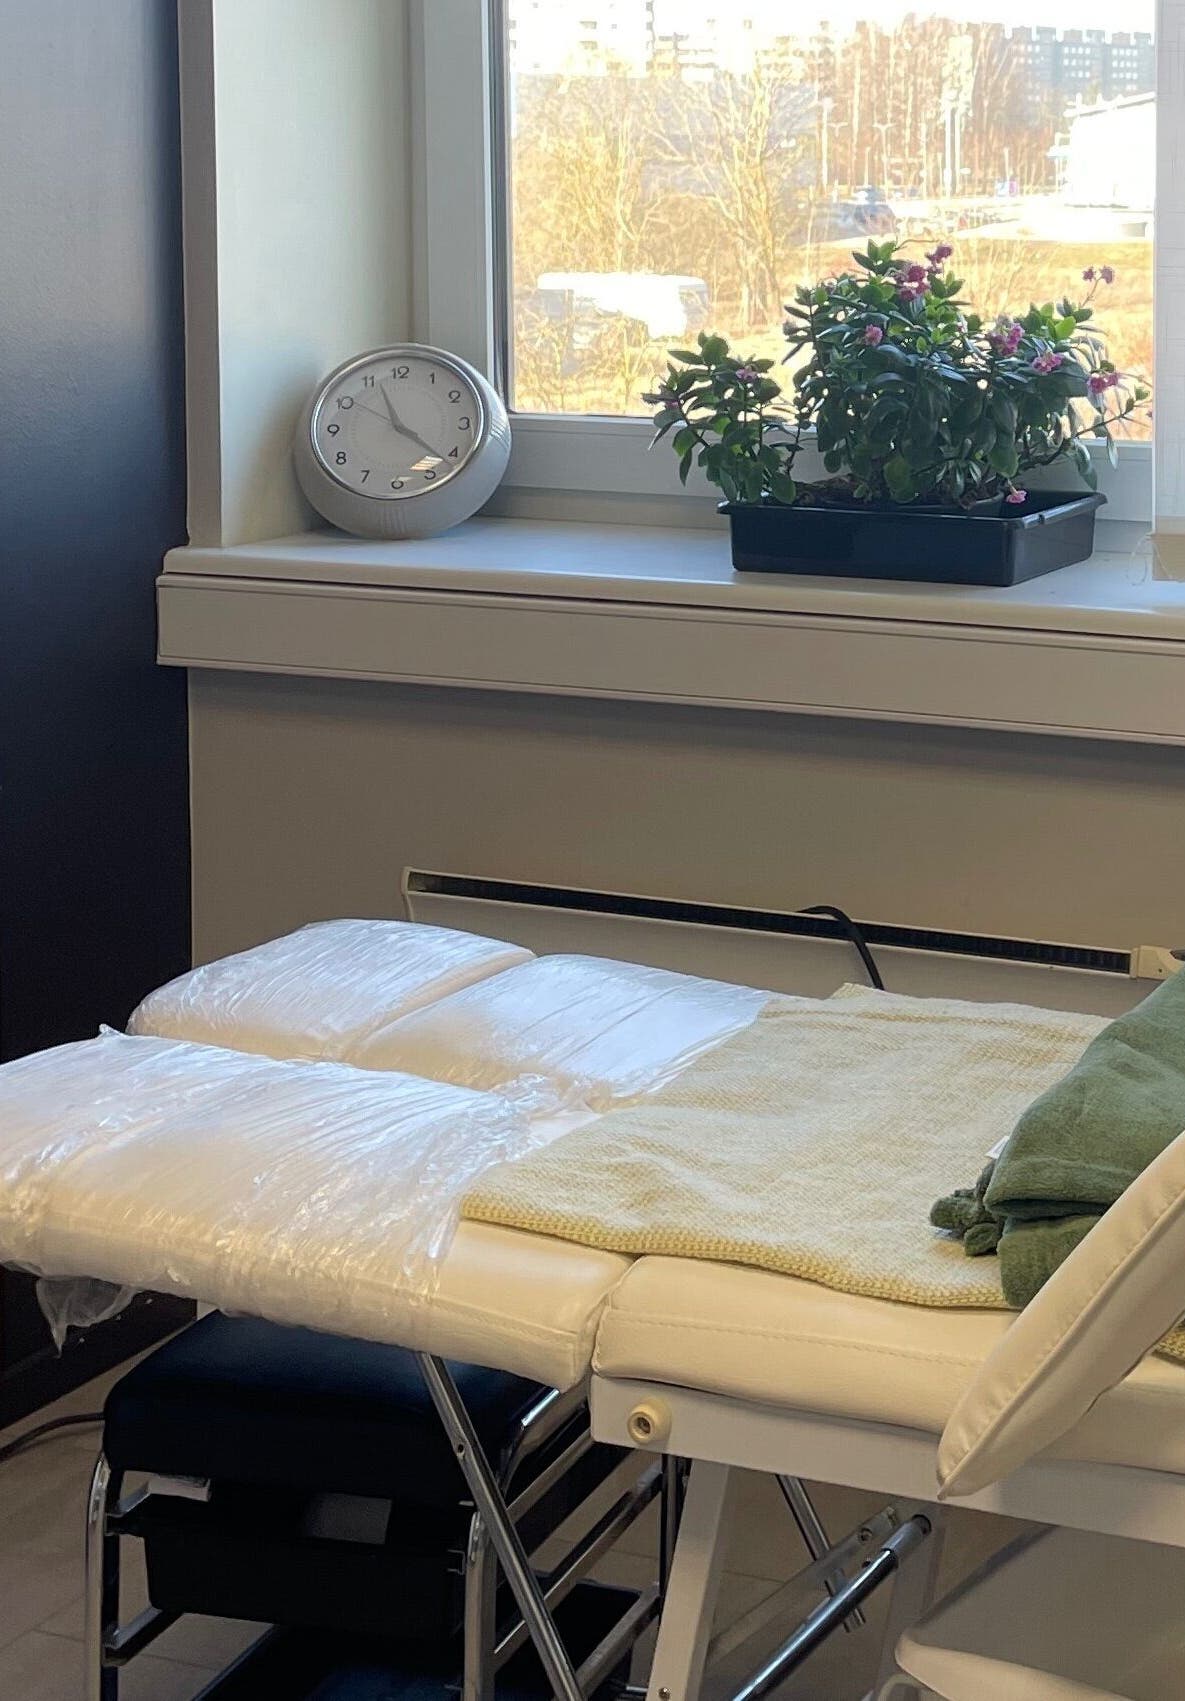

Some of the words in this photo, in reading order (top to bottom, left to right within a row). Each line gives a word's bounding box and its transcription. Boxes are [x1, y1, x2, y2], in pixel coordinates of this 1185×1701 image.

[391, 366, 410, 379] 12
[429, 372, 436, 384] 1
[362, 375, 375, 387] 11
[336, 396, 354, 410] 10
[448, 390, 461, 404] 2
[327, 423, 340, 437] 9
[458, 416, 470, 430] 3
[336, 451, 347, 465] 8
[448, 446, 459, 458] 4
[361, 469, 370, 483] 7
